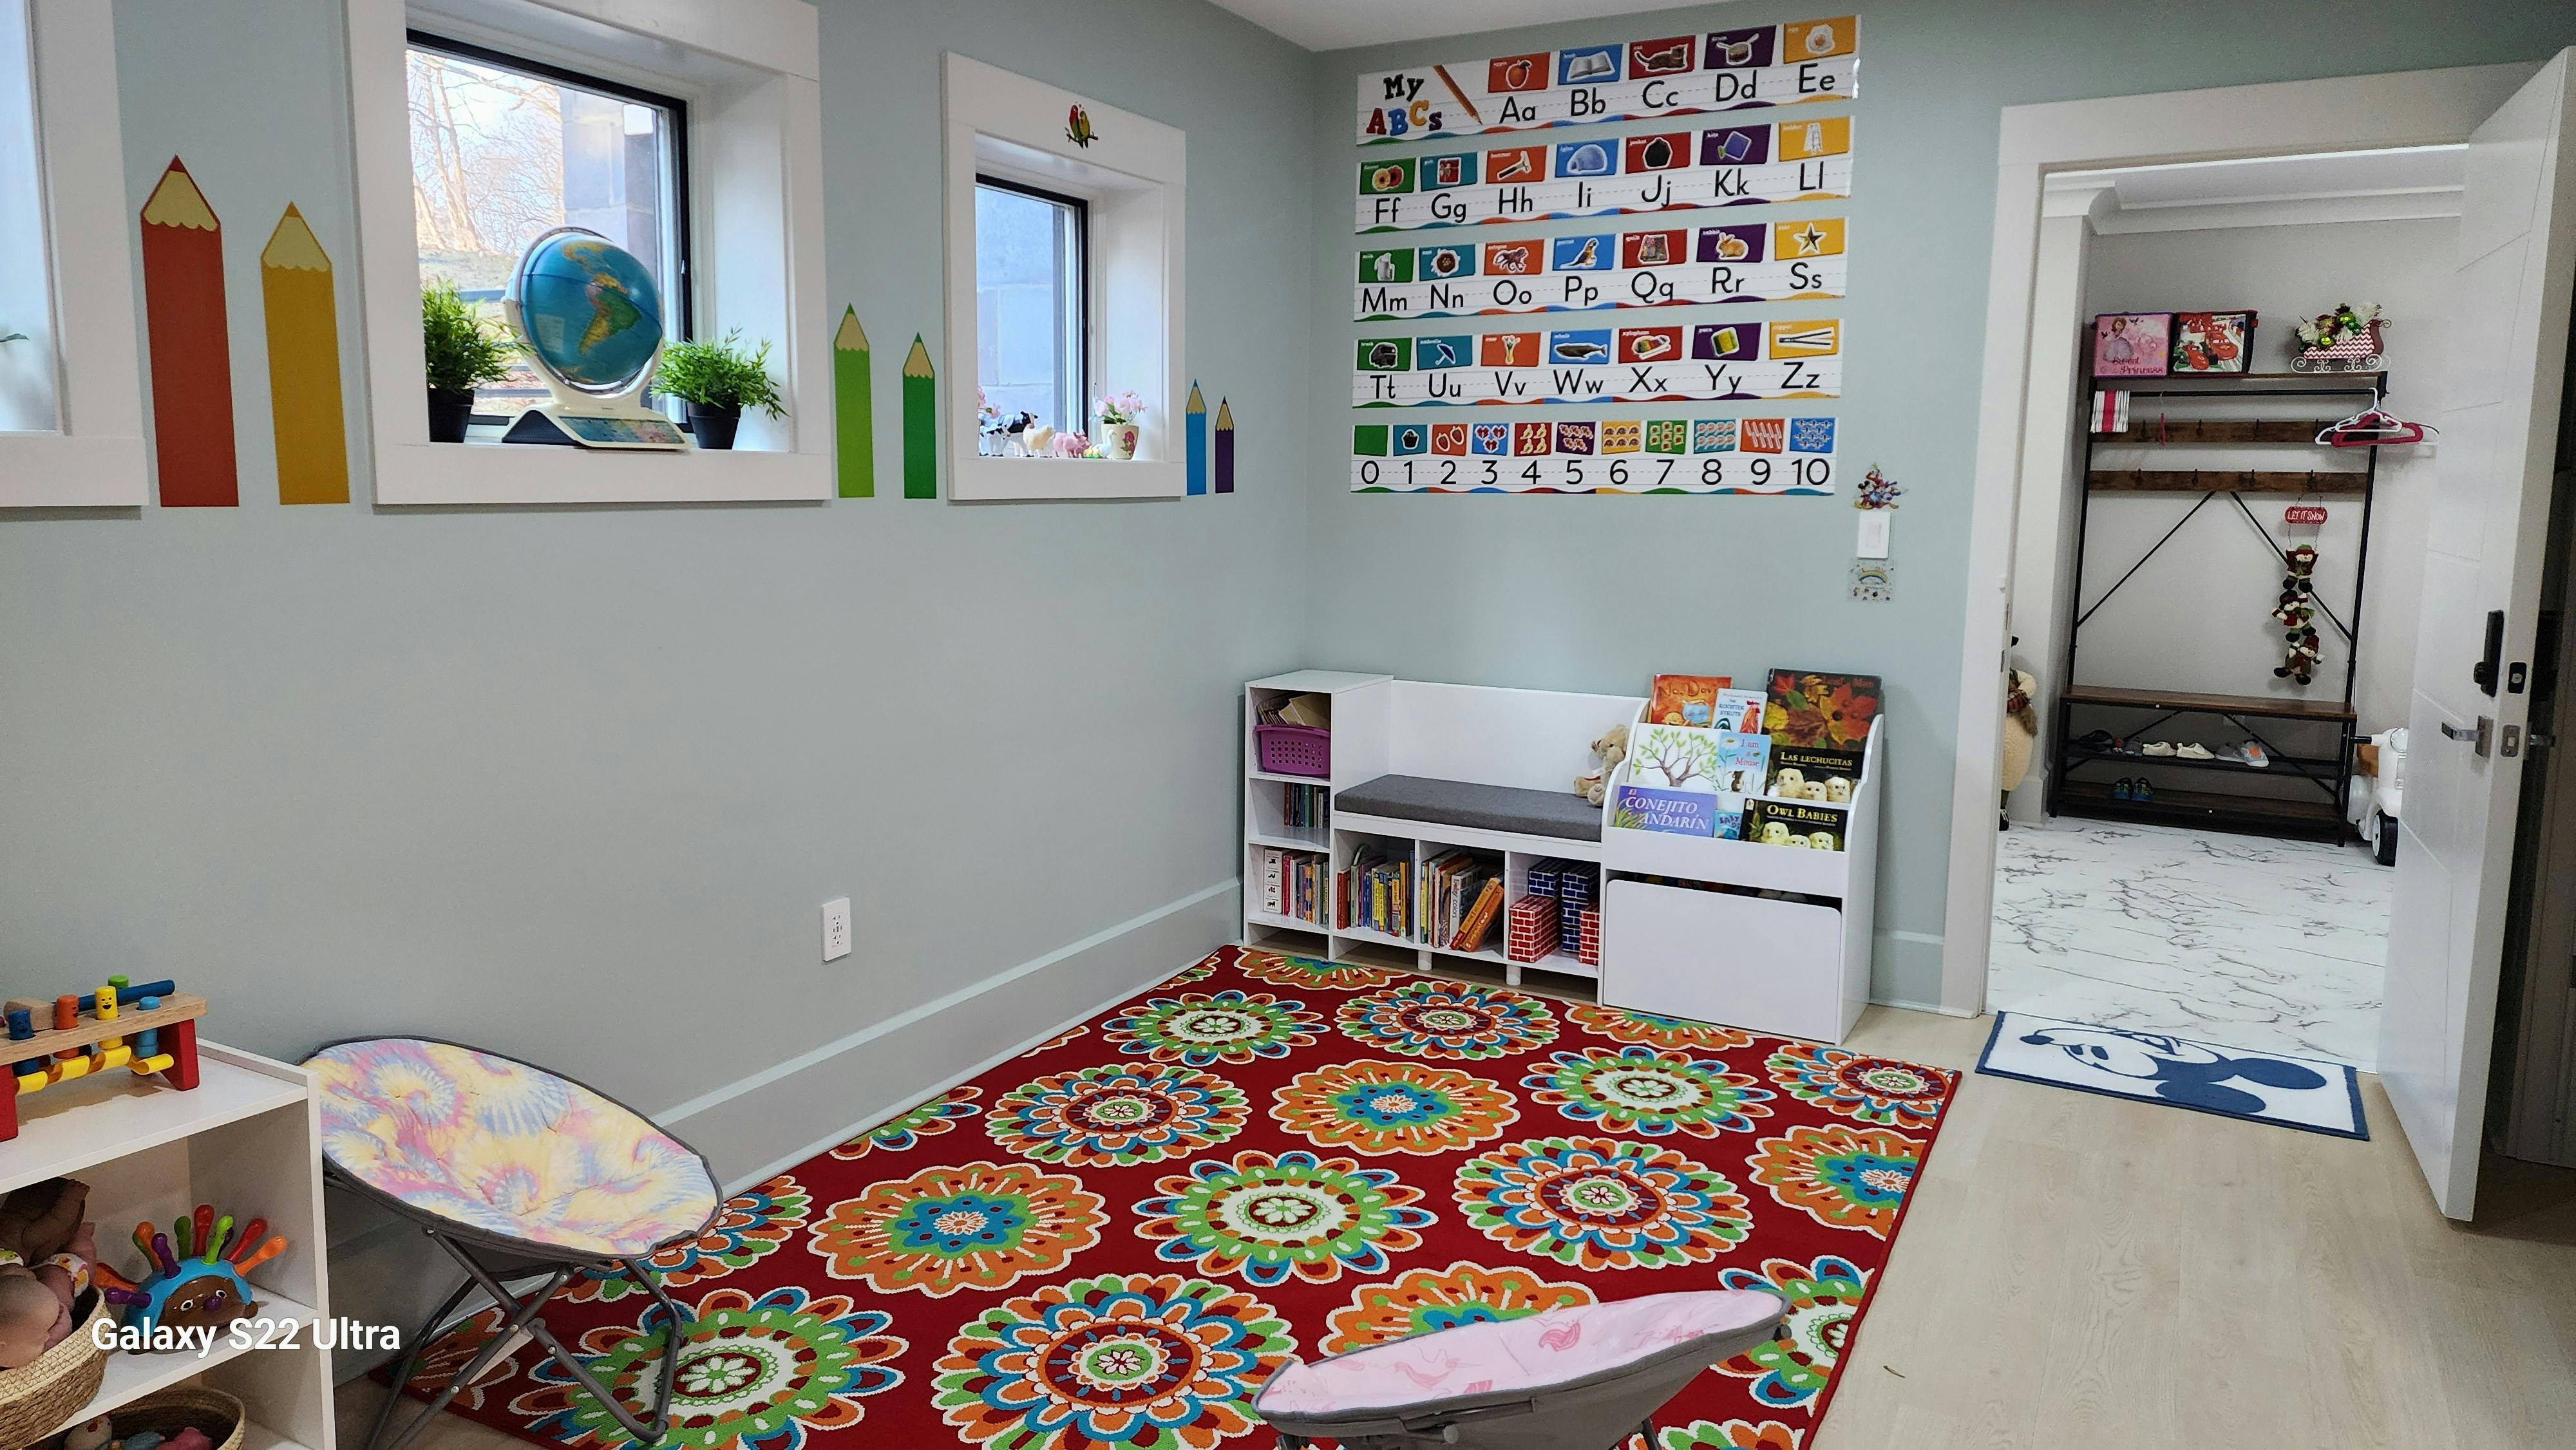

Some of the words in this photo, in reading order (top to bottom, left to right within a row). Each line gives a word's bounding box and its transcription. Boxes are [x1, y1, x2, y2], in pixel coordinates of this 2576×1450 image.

[1383, 73, 1425, 102] My
[1499, 95, 1536, 124] Aa
[1570, 87, 1606, 117] Bb
[1642, 80, 1679, 109] Cc
[1716, 69, 1757, 103] Dd
[1798, 62, 1835, 94] Ee
[1366, 100, 1443, 136] ABCs
[1375, 196, 1401, 224] Ff
[1431, 193, 1466, 223] Gg
[1499, 186, 1533, 214] Hh
[1578, 181, 1591, 208] Ii
[1641, 174, 1671, 207] Jj
[1714, 168, 1750, 198] Kk
[1799, 161, 1824, 191] Ll
[1361, 287, 1407, 313] Mm
[1430, 283, 1464, 310] Nn
[1493, 279, 1532, 306] Oo
[1565, 276, 1598, 303] Pp
[1631, 271, 1674, 303] Qq
[1712, 267, 1745, 294] Rr
[1789, 262, 1822, 290] Ss
[1369, 374, 1396, 399] Tt
[1428, 373, 1461, 398] Uu
[1495, 370, 1527, 397] Vv
[1553, 368, 1604, 395] Ww
[1628, 366, 1667, 393] Xx
[1704, 364, 1742, 395] Yy
[1781, 361, 1820, 389] Zz
[1361, 460, 1379, 485] 0
[1403, 460, 1413, 485] 1
[1440, 460, 1457, 485] 2
[1481, 460, 1498, 485] 3
[1520, 460, 1542, 485] 4
[1566, 459, 1583, 485] 5
[1609, 459, 1629, 485] 6
[1656, 459, 1674, 485] 7
[1701, 458, 1722, 485] 8
[1750, 458, 1771, 485] 9
[1791, 458, 1830, 485] 10
[2287, 511, 2300, 520] LET
[2300, 511, 2307, 520] IT
[2307, 511, 2325, 520] SNOW
[1741, 739, 1745, 748] I
[1734, 757, 1760, 767] Mouse
[1780, 752, 1798, 762] LAS
[1801, 755, 1853, 766] LECHUCITAS
[1625, 796, 1698, 814] CONEJITO
[1766, 804, 1794, 817] OWL
[1797, 807, 1838, 822] BABIES
[1639, 811, 1709, 830] ANDARÍN
